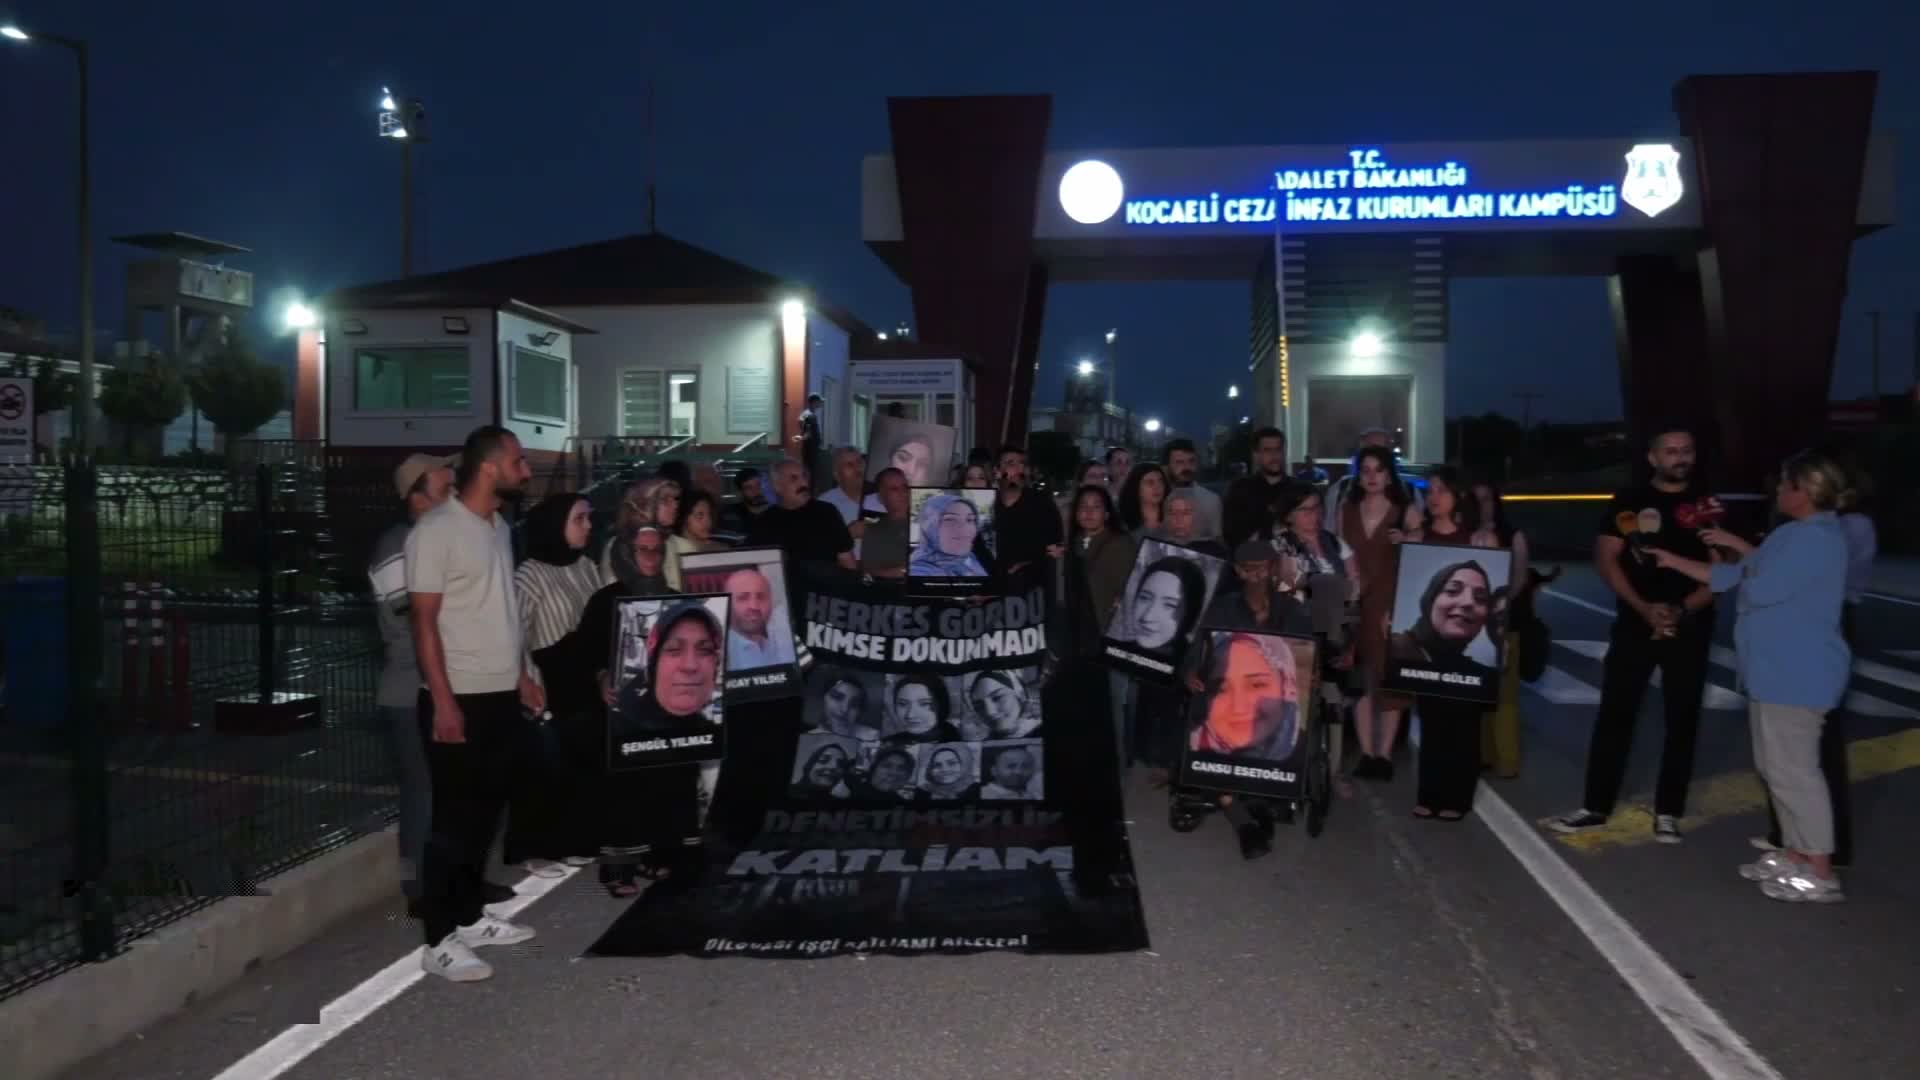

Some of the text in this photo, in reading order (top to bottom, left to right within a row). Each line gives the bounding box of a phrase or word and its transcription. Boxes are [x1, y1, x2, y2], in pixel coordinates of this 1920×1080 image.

[1350, 150, 1386, 168] T.C.
[1353, 162, 1466, 188] BAKANLIĞI
[1126, 192, 1219, 224] KOCAELİ
[1286, 191, 1352, 221] İNFAZ
[1357, 194, 1493, 219] KURUMLARI
[1499, 186, 1616, 216] KAMPÜSÜ
[806, 592, 930, 636] HERKES
[806, 621, 1047, 664] KİMSE DOKUNMADI
[670, 734, 713, 748] YILMAZ
[1192, 760, 1297, 783] CANSU ESETOĞLU
